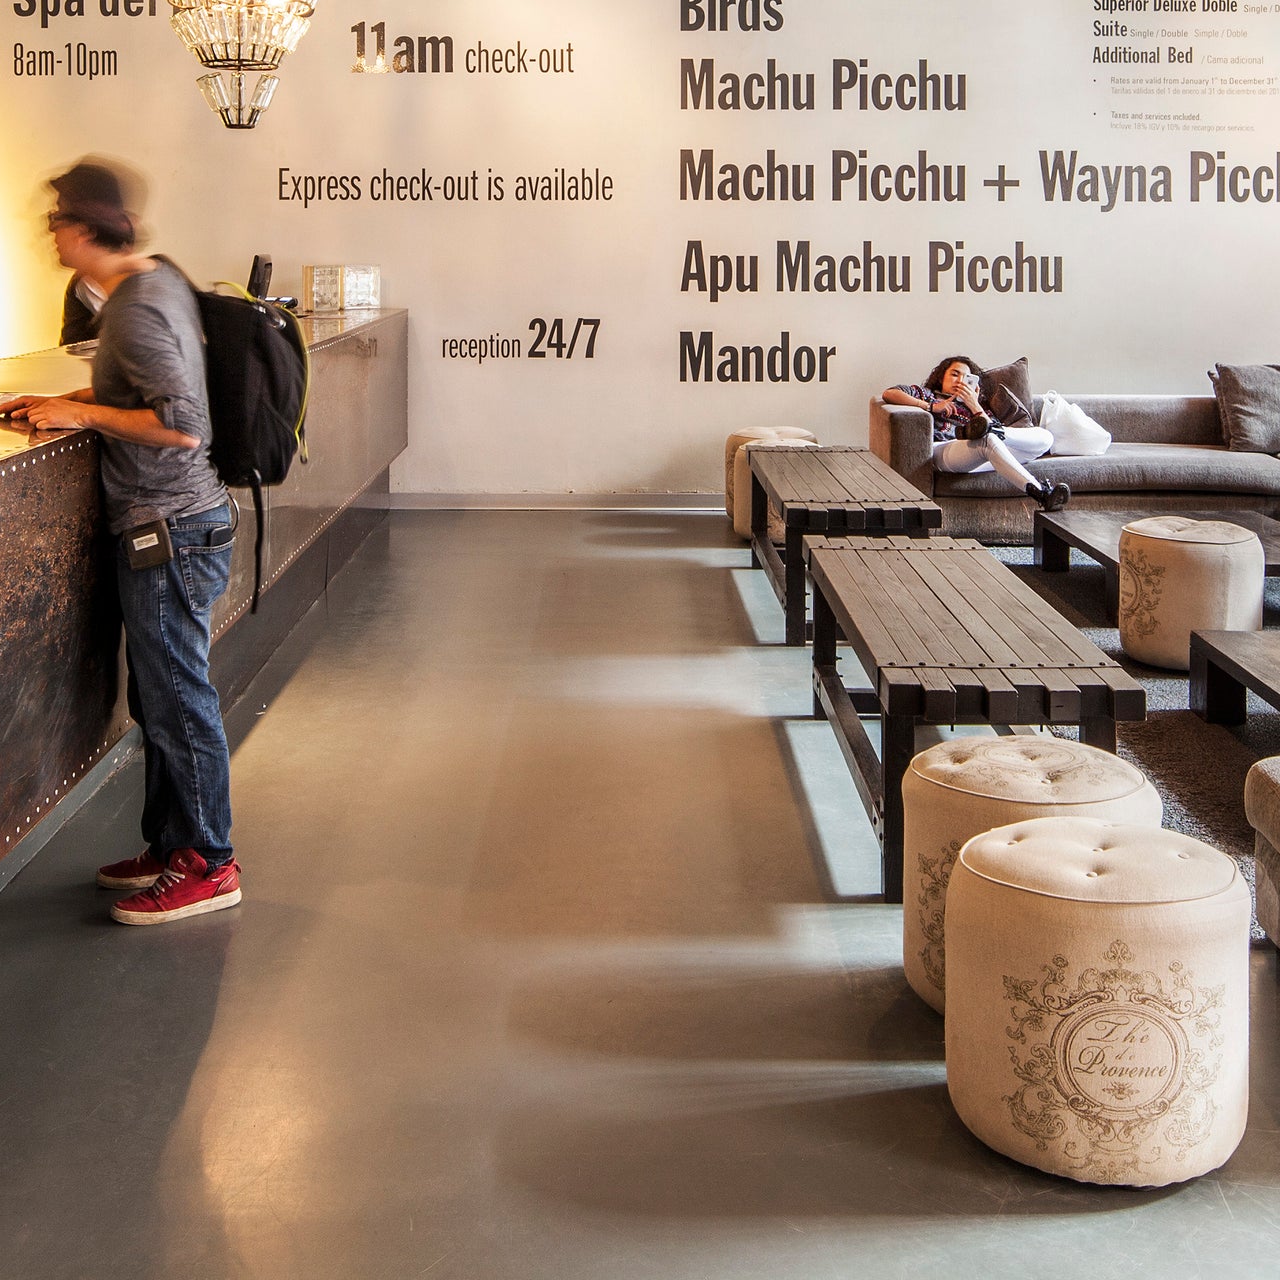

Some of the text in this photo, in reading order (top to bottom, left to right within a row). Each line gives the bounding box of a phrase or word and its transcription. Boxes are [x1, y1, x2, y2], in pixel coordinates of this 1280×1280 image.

[1243, 4, 1267, 14] Single
[351, 21, 574, 73] 11am check-out
[1093, 21, 1128, 37] Suite
[1130, 28, 1154, 38] Single
[1161, 29, 1188, 38] Double
[14, 43, 117, 80] 8am-10pm
[1093, 47, 1160, 64] Additional
[1168, 47, 1193, 64] Bed
[1230, 56, 1264, 65] adicional
[681, 58, 966, 111] Machu Picchu
[1181, 77, 1209, 86] January
[1229, 77, 1264, 85] December
[1111, 111, 1129, 119] Taxes
[279, 168, 613, 208] Express check-out is available
[680, 149, 814, 201] Machu
[832, 150, 965, 202] Picchu
[983, 165, 1020, 201] +
[1039, 150, 1172, 212] Wayna
[680, 240, 1062, 302] Apu Machu Picchu
[443, 318, 600, 364] reception 24/7
[680, 331, 836, 382] Mandor
[1086, 1015, 1151, 1044] Thé
[1073, 1045, 1168, 1078] Provence
